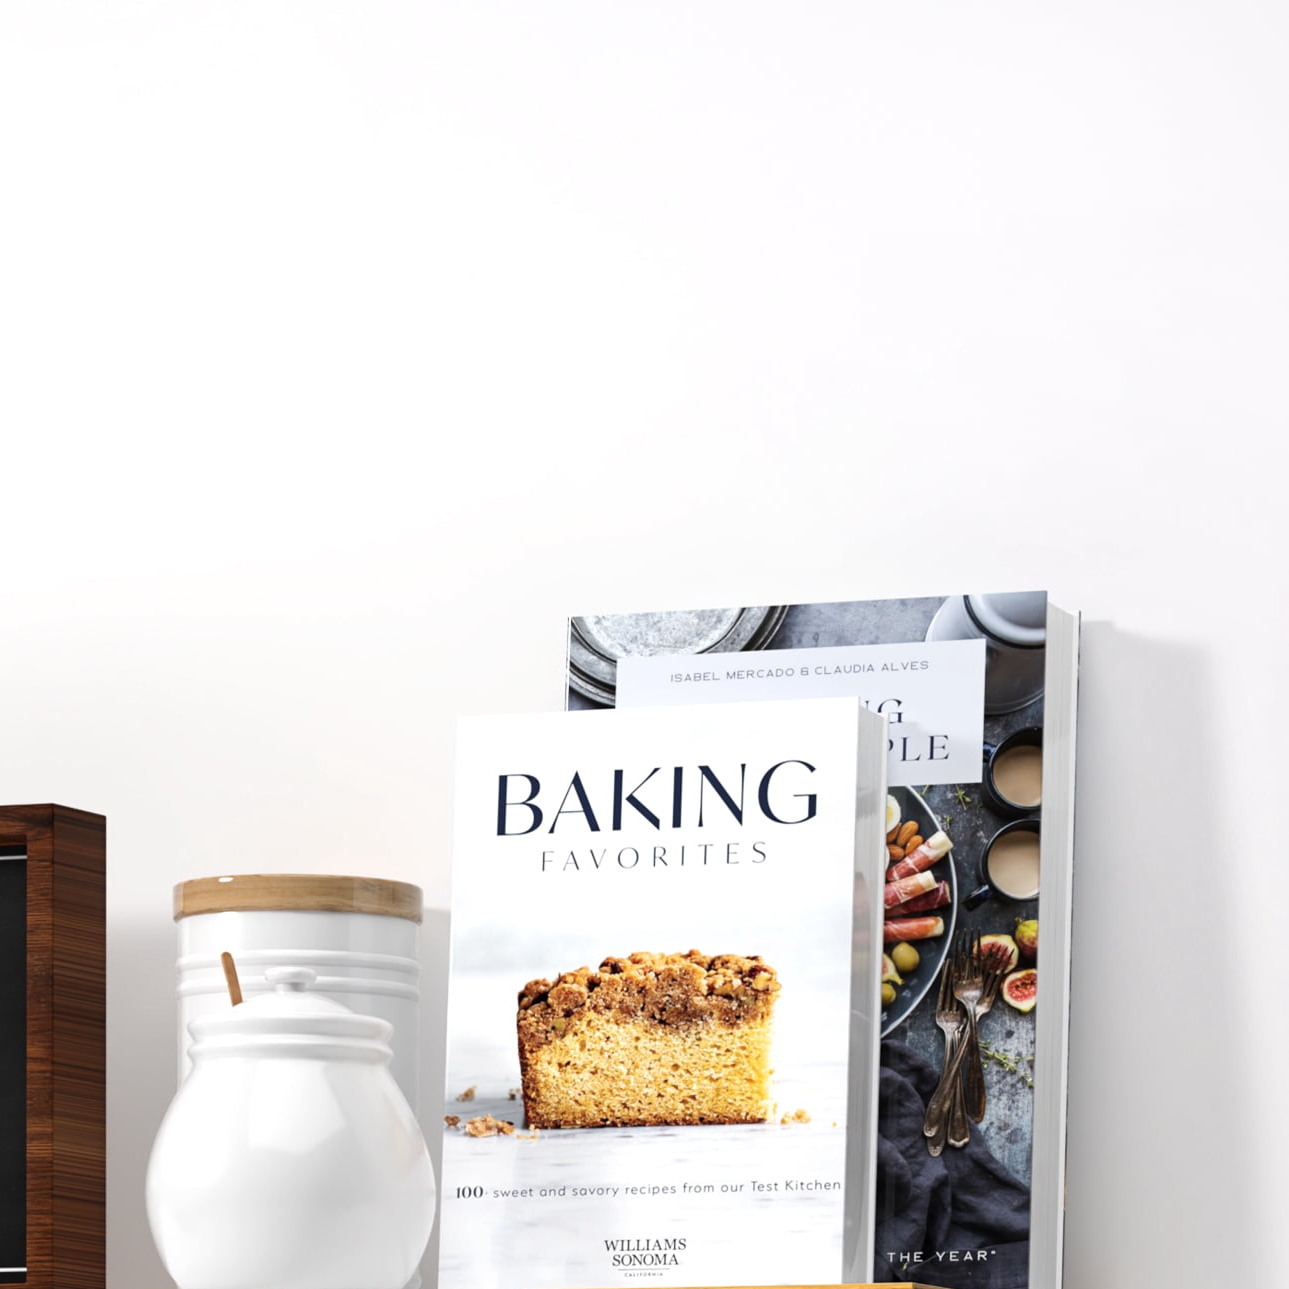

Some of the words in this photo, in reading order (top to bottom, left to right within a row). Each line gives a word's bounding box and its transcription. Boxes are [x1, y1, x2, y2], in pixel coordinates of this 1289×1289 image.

[670, 671, 721, 683] ISABEL
[726, 668, 795, 680] MERCADO
[814, 663, 875, 676] CLAUDIA
[881, 660, 930, 672] ALVES
[497, 759, 818, 837] BAKING
[541, 840, 767, 873] FAVORITES
[493, 1187, 534, 1198] sweet
[539, 1185, 566, 1198] and
[572, 1186, 619, 1197] savory
[625, 1183, 677, 1196] recipes
[683, 1182, 715, 1193] from
[720, 1183, 744, 1193] our
[751, 1180, 779, 1192] Test
[784, 1179, 842, 1191] Kitchen
[604, 1238, 687, 1252] WILLIAMS
[612, 1253, 679, 1267] SONOMA
[887, 1251, 924, 1262] THE
